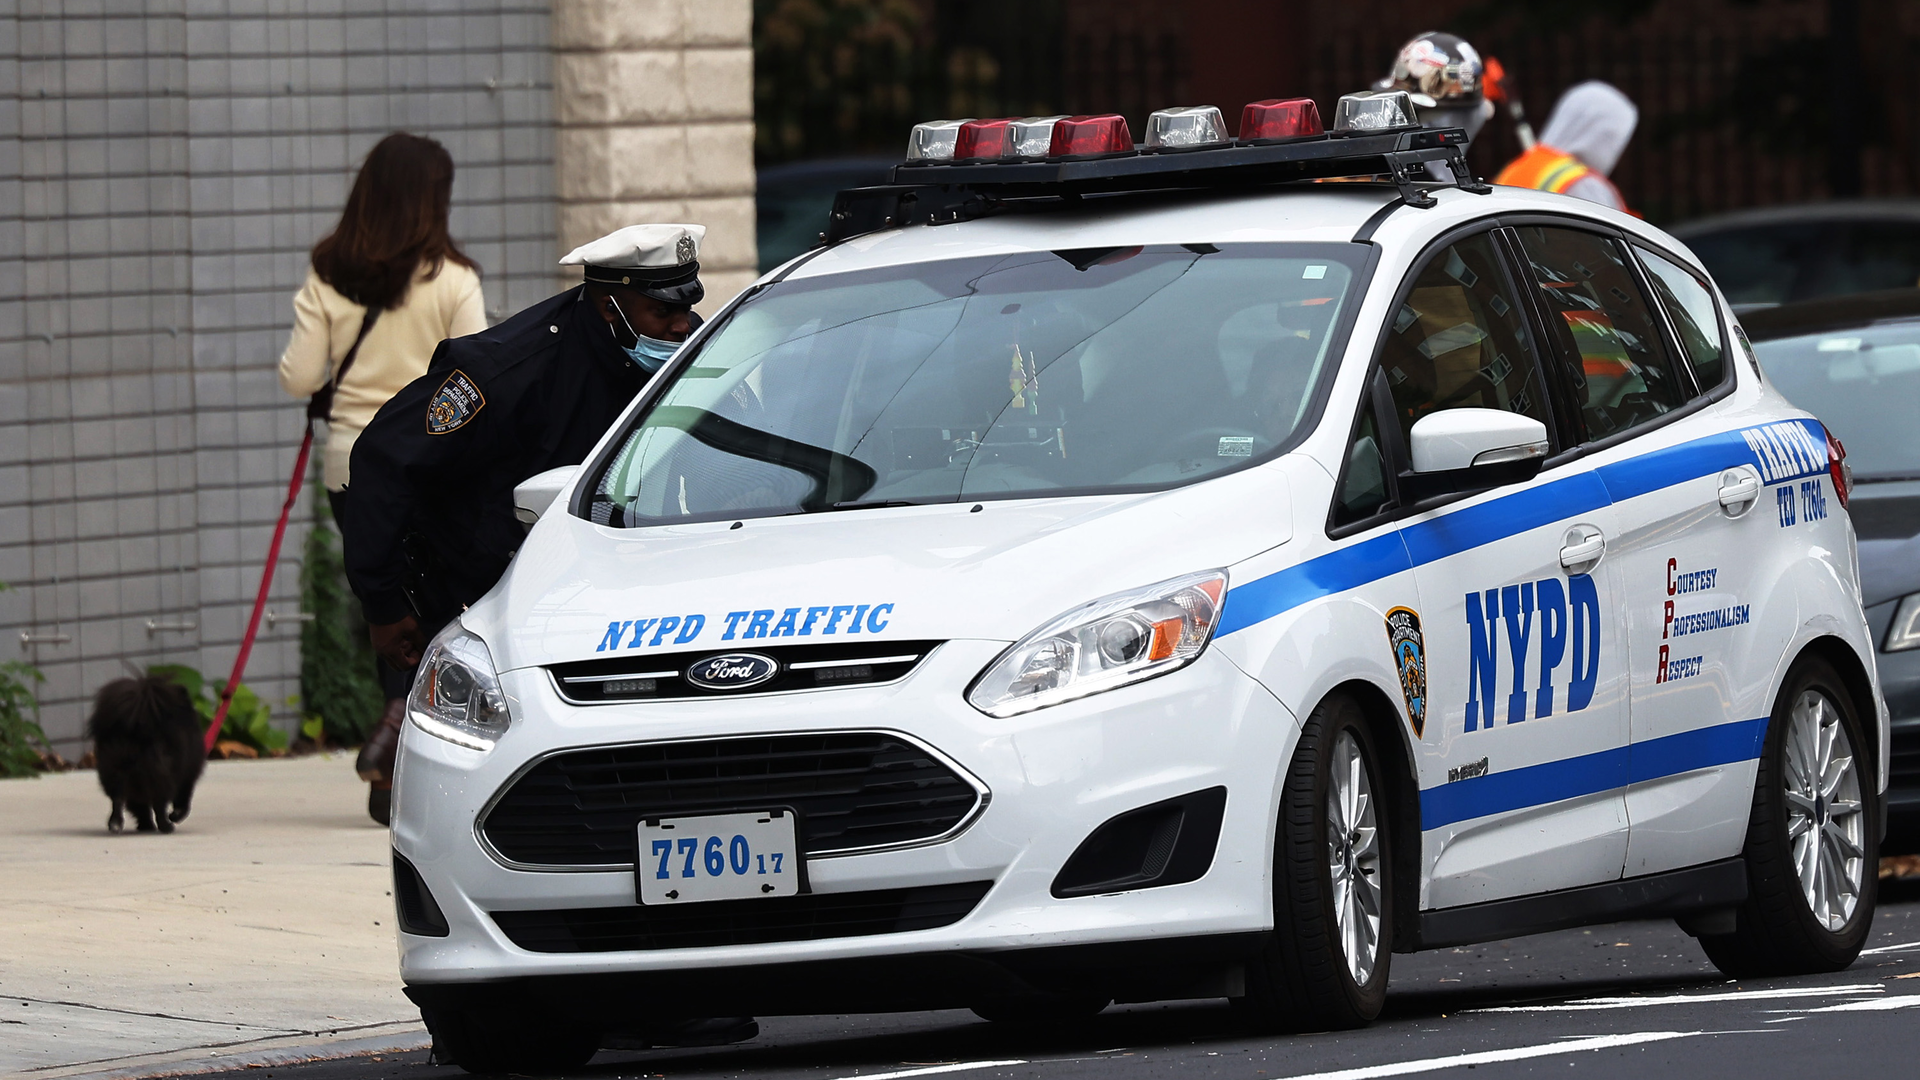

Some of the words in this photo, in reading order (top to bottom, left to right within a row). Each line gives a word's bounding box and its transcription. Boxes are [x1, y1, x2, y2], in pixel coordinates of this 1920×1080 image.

[442, 386, 470, 417] DEPARTMENT
[452, 386, 470, 406] POLICE
[457, 376, 479, 401] TRAFFIC
[448, 419, 463, 430] YORK
[1740, 420, 1826, 482] TRAFFIC
[1776, 485, 1796, 528] TED
[1801, 479, 1823, 523] 7760
[1666, 557, 1718, 597] COURTESY
[596, 613, 706, 653] NYPD
[720, 602, 895, 641] TRAFFIC
[1390, 613, 1411, 630] POLICE
[1391, 626, 1421, 652] DEPARTMENT
[1662, 600, 1750, 640] PROFESSIONALISM
[705, 657, 755, 680] Ford
[1463, 574, 1601, 734] NYPD
[1656, 643, 1703, 684] RESPECT
[651, 834, 750, 880] 7760
